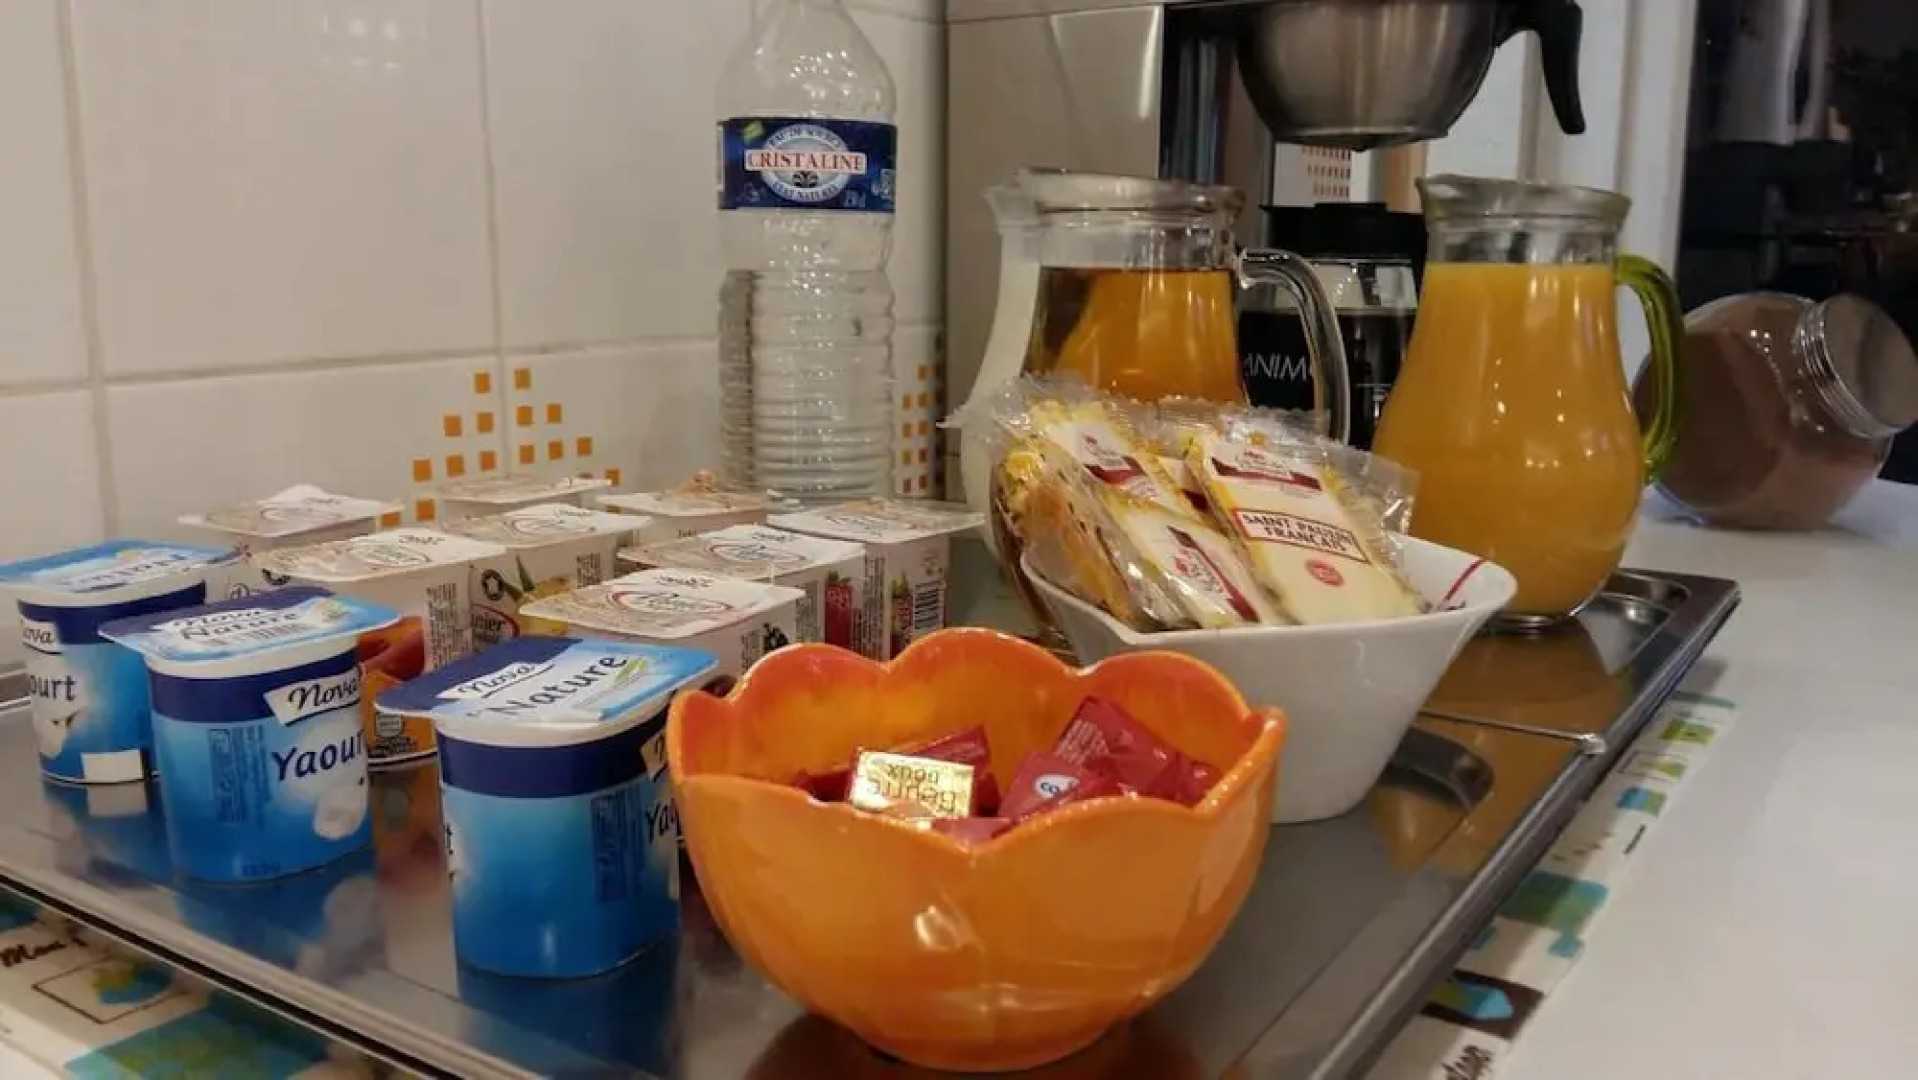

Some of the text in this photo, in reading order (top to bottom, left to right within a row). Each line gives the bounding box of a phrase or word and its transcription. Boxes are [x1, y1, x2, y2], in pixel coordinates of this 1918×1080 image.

[747, 152, 862, 170] CRISTALINE
[1244, 352, 1313, 382] ANIM
[1242, 513, 1352, 544] SAINT PAULIN
[458, 663, 536, 694] Nova
[485, 655, 629, 717] Nature
[288, 678, 361, 711] Nova
